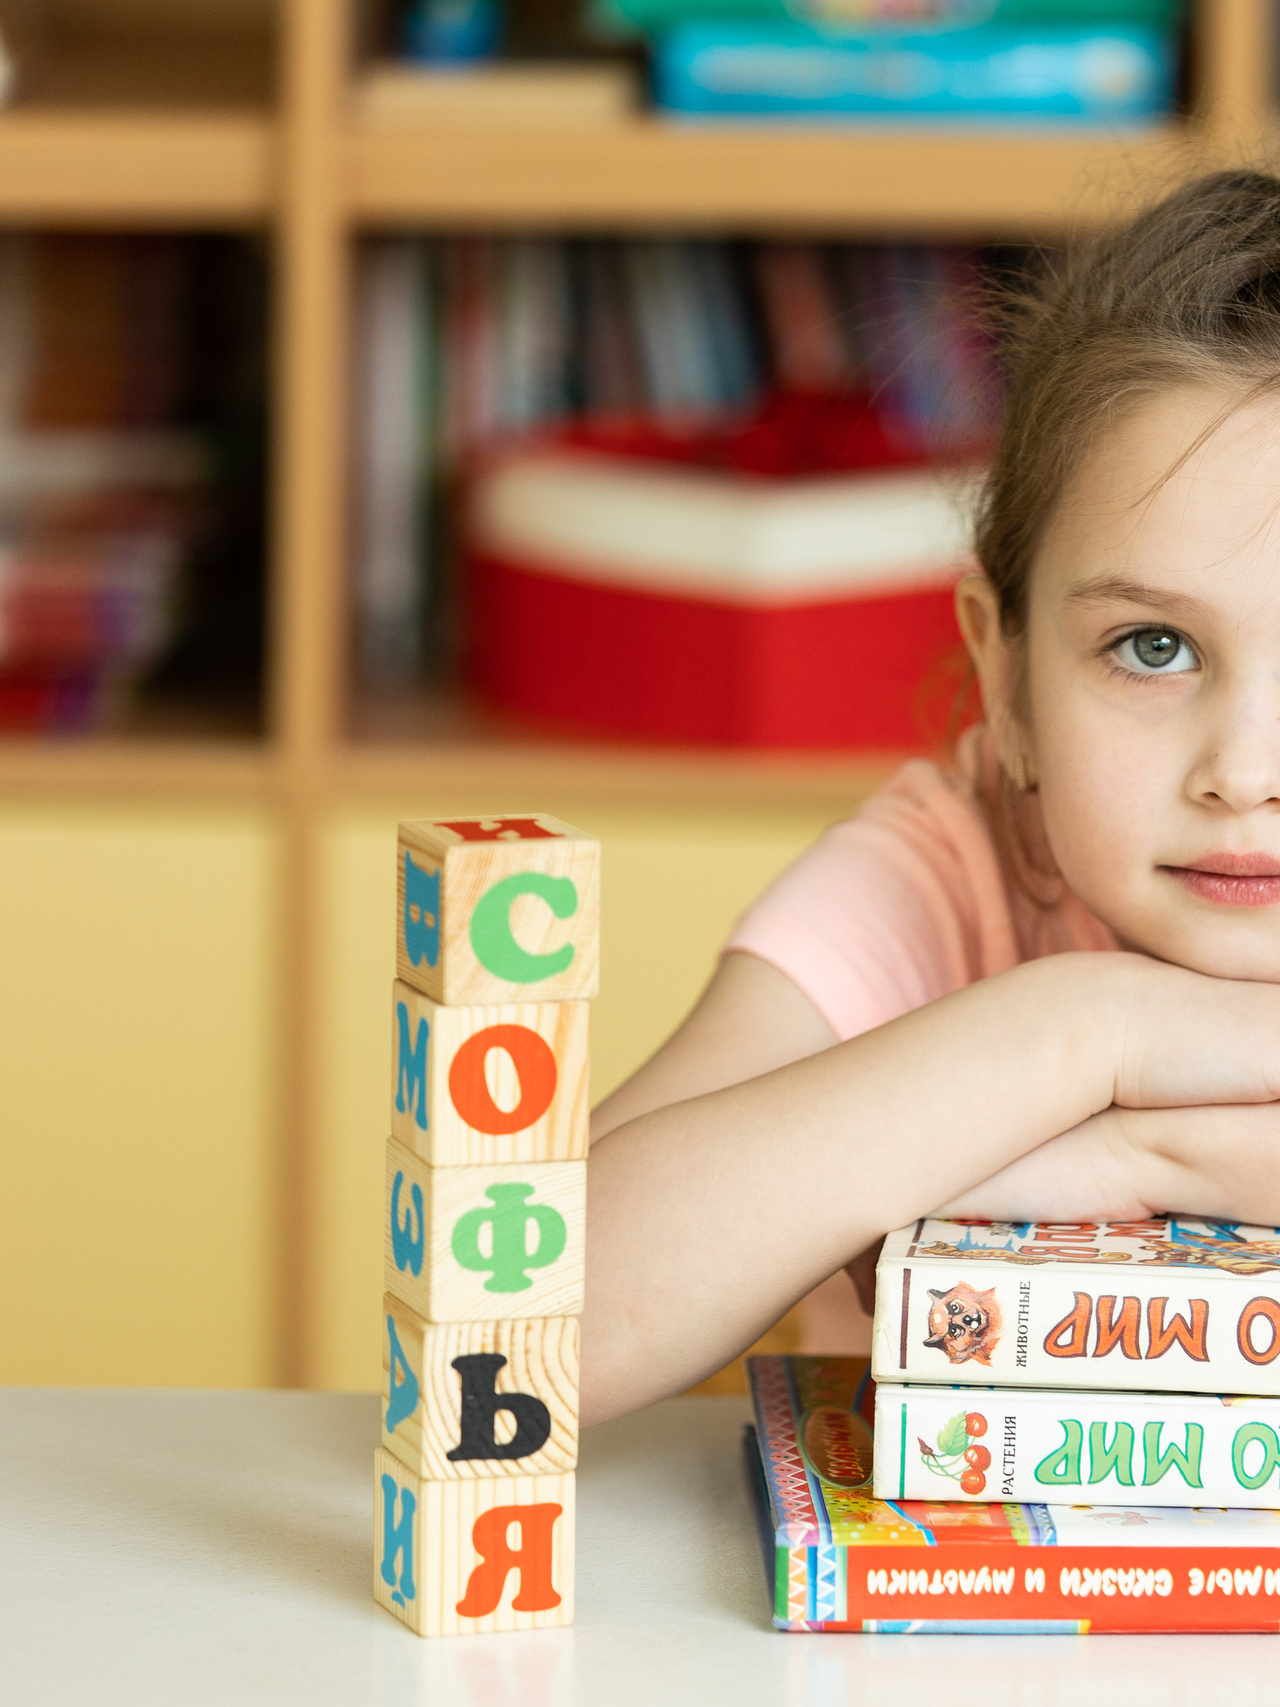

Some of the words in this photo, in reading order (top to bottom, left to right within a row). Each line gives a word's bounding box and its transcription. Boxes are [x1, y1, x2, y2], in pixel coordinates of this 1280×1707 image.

[395, 1001, 430, 1131] М
[1015, 1281, 1032, 1368] ЖИВОТНЫЕ
[1042, 1290, 1211, 1363] МИР
[1000, 1415, 1017, 1496] РАСТЕНИЯ
[1034, 1418, 1204, 1489] МИР
[866, 1566, 1015, 1595] МУЛЬТИКИ
[1024, 1567, 1046, 1594] И
[1059, 1567, 1174, 1597] СКАЗКИ
